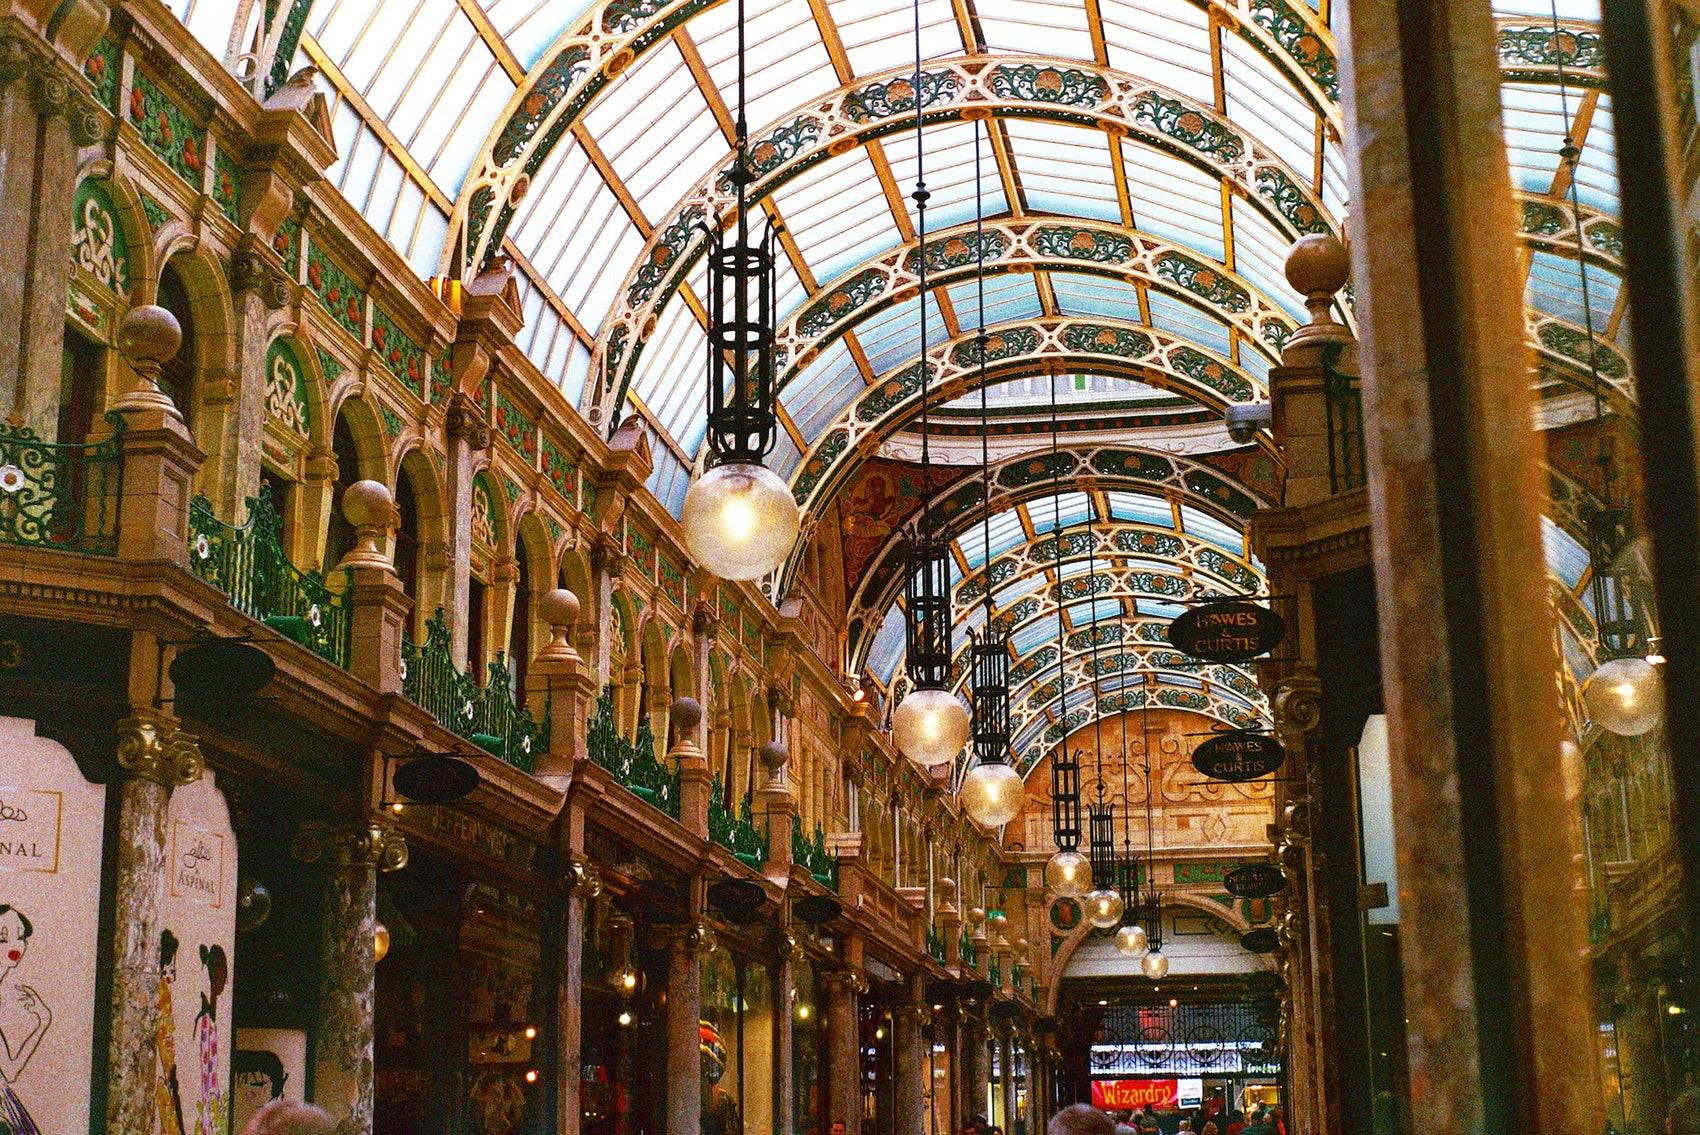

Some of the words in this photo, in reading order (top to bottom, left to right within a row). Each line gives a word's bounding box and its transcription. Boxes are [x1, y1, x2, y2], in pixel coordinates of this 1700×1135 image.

[1196, 612, 1257, 628] HAWES
[1221, 628, 1231, 638] &
[1194, 636, 1259, 653] CURTIS
[1215, 740, 1263, 753] HAWES
[1213, 760, 1265, 774] CURTIS
[177, 869, 215, 894] ASPINAL
[1100, 1080, 1171, 1107] Wizardry
